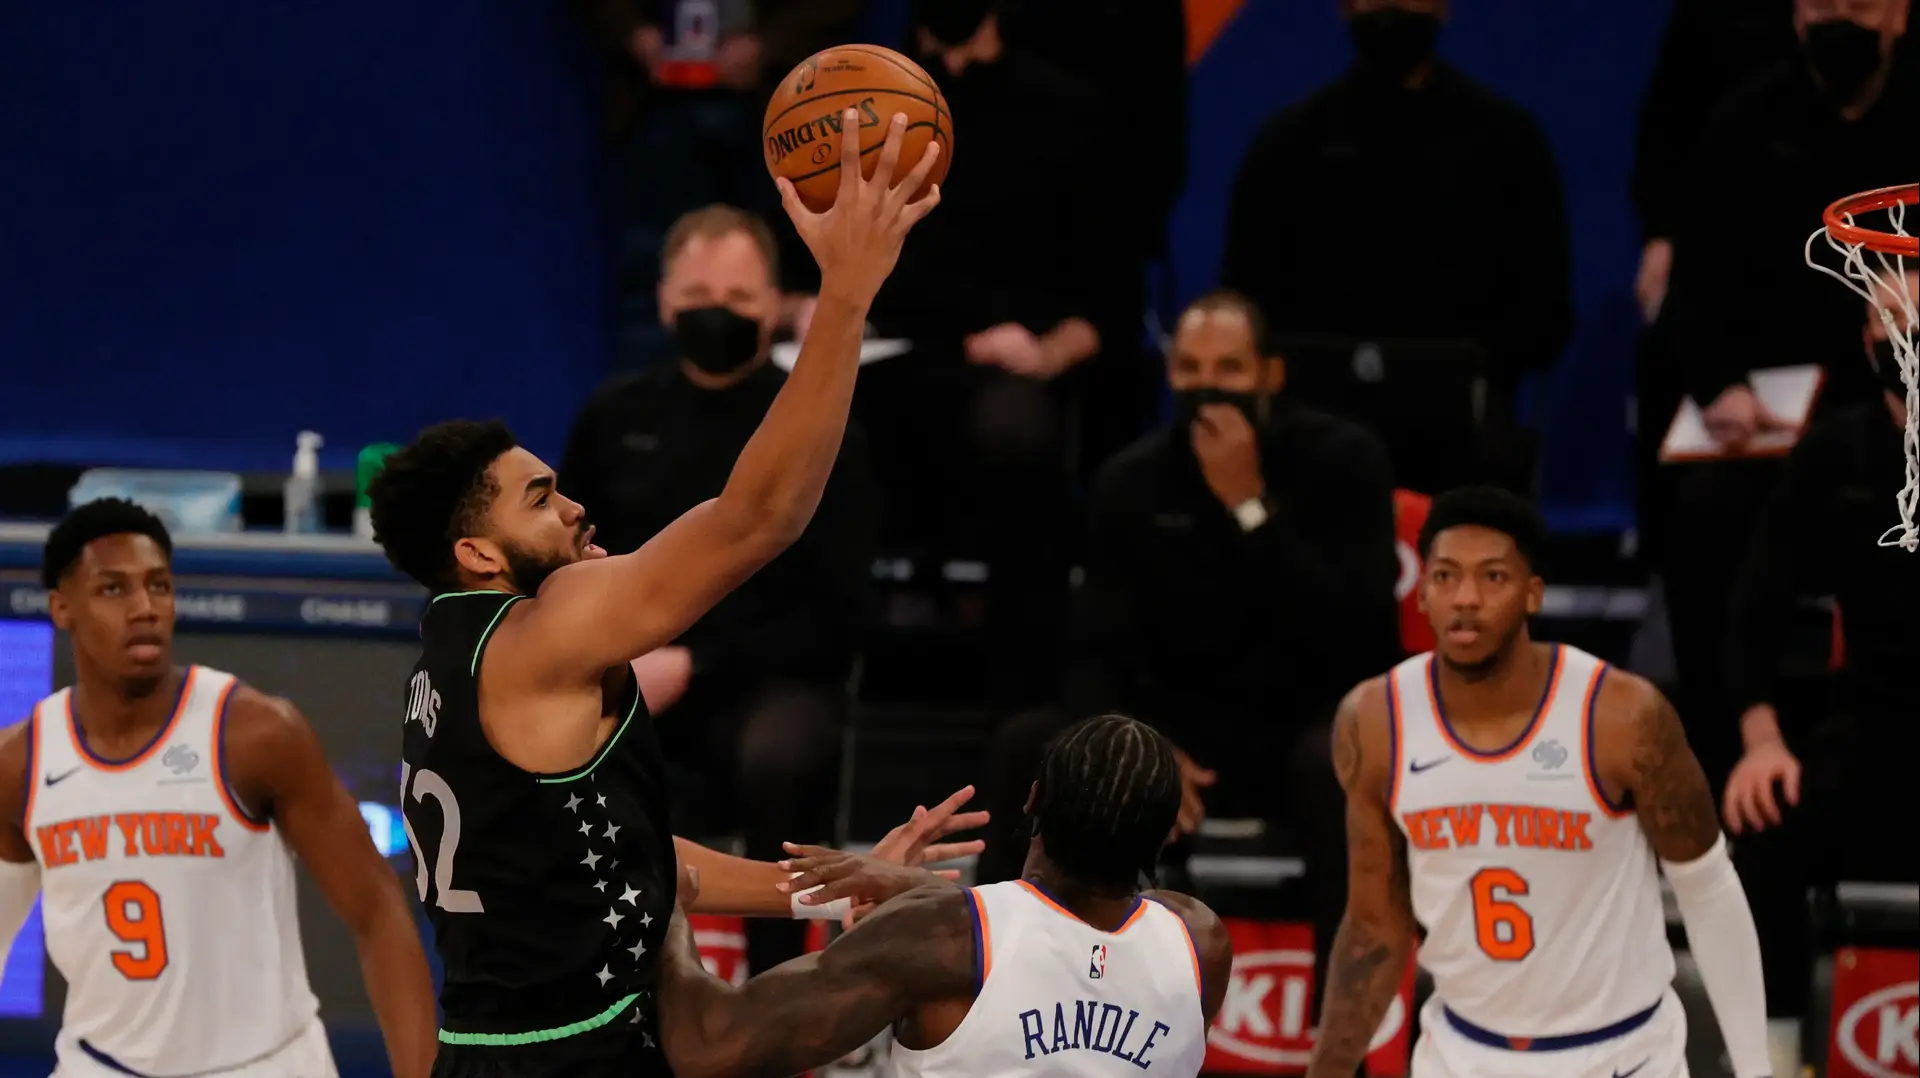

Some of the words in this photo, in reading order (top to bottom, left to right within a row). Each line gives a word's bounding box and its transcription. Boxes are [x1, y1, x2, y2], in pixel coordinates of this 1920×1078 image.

[37, 815, 111, 870] NEW
[115, 811, 224, 858] YORK
[1402, 803, 1483, 850] NEW
[1487, 804, 1593, 851] YORK
[103, 880, 168, 981] 9
[1470, 867, 1535, 962] 6
[1019, 999, 1171, 1070] RANDLE
[1220, 973, 1320, 1041] KI
